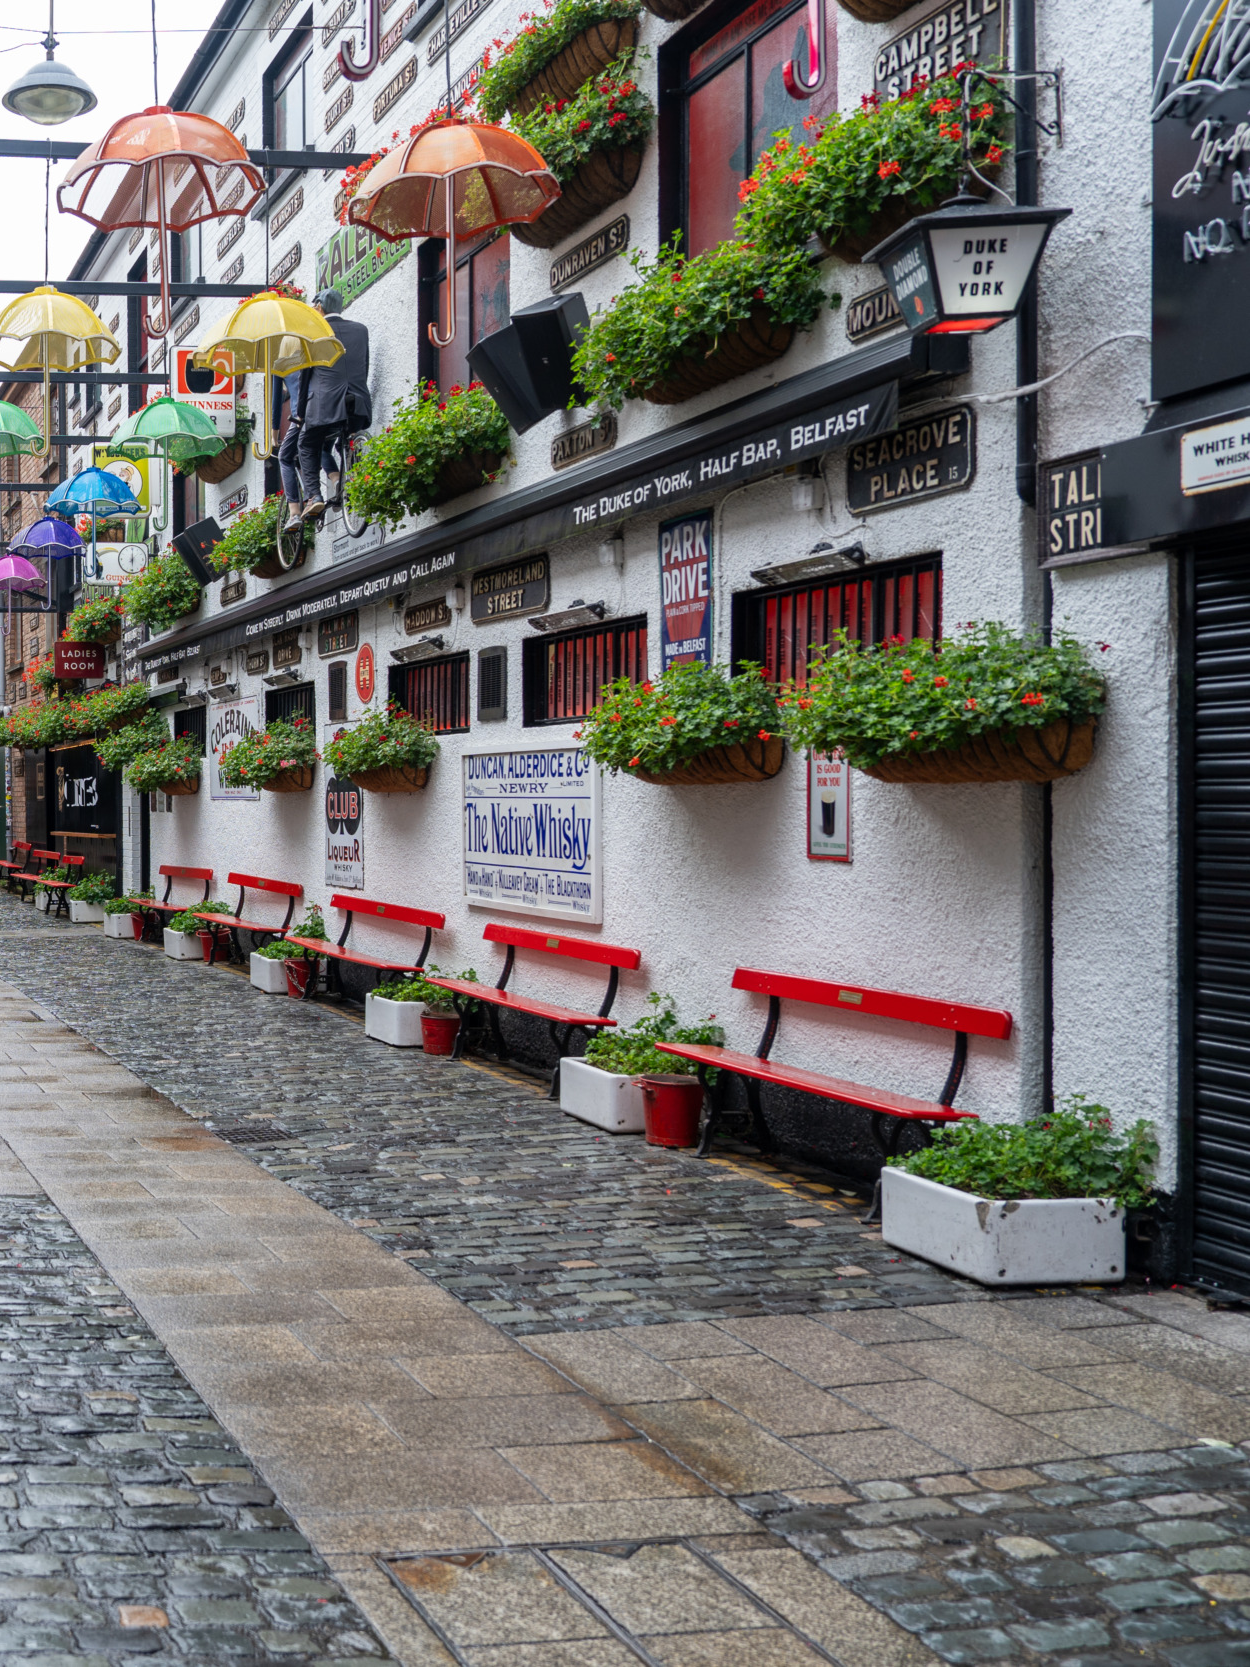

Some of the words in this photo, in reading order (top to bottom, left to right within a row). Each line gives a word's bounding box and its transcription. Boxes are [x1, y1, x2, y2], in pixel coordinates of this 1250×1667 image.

[427, 0, 479, 61] CHAREVILLE
[875, 0, 998, 82] CAMPBELL
[887, 24, 983, 101] STREET
[373, 76, 404, 122] FORTUNA
[318, 222, 386, 290] RALEI
[551, 234, 605, 287] DUNRAVEN
[963, 238, 1008, 255] DUKE
[892, 247, 921, 282] DOUBLE
[972, 260, 994, 276] OF
[895, 265, 928, 302] DIAMOND
[959, 280, 1004, 297] YORK
[551, 433, 596, 464] PAXTON
[1193, 436, 1236, 457] WHITE
[1215, 450, 1250, 467] WHISK
[573, 506, 598, 526] THE
[600, 491, 632, 517] DUKE
[633, 485, 652, 505] OF
[653, 469, 693, 498] YORK,
[699, 450, 740, 482] HALF
[741, 438, 782, 467] BAP,
[790, 403, 871, 451] BELFAST
[870, 458, 940, 502] PLACE
[1051, 462, 1101, 509] TAL
[661, 520, 708, 567] PARK
[286, 608, 302, 624] DRINK
[302, 594, 338, 617] MODERATELY,
[340, 584, 363, 604] DEPART
[363, 577, 390, 598] QUIETLY
[392, 569, 408, 587] AND
[410, 562, 429, 580] CALL
[431, 551, 455, 574] AGAIN
[473, 561, 545, 596] WESTMORELAND
[662, 561, 709, 606] DRIVE
[488, 588, 524, 615] STREET
[405, 606, 436, 631] HADDOW
[61, 649, 97, 659] LADIES
[325, 632, 348, 651] STREET
[665, 641, 679, 657] MADE
[683, 637, 707, 654] BELFAST
[64, 662, 95, 671] ROOM
[468, 754, 507, 780] DUNCAN,
[507, 751, 564, 779] ALDERDICE
[566, 755, 573, 777] &
[816, 764, 823, 774] IS
[824, 763, 842, 774] GOOD
[499, 782, 549, 794] NEWRY
[563, 780, 584, 788] LIMITED
[817, 777, 828, 787] FOR
[829, 777, 841, 787] YOU
[327, 791, 359, 820] CLUB
[327, 838, 361, 864] LIQUEUR
[467, 802, 489, 853] The
[491, 803, 534, 857] Native
[533, 802, 591, 871] Whisky
[333, 864, 354, 874] WHISKY
[556, 874, 592, 900] BLACKTHORN
